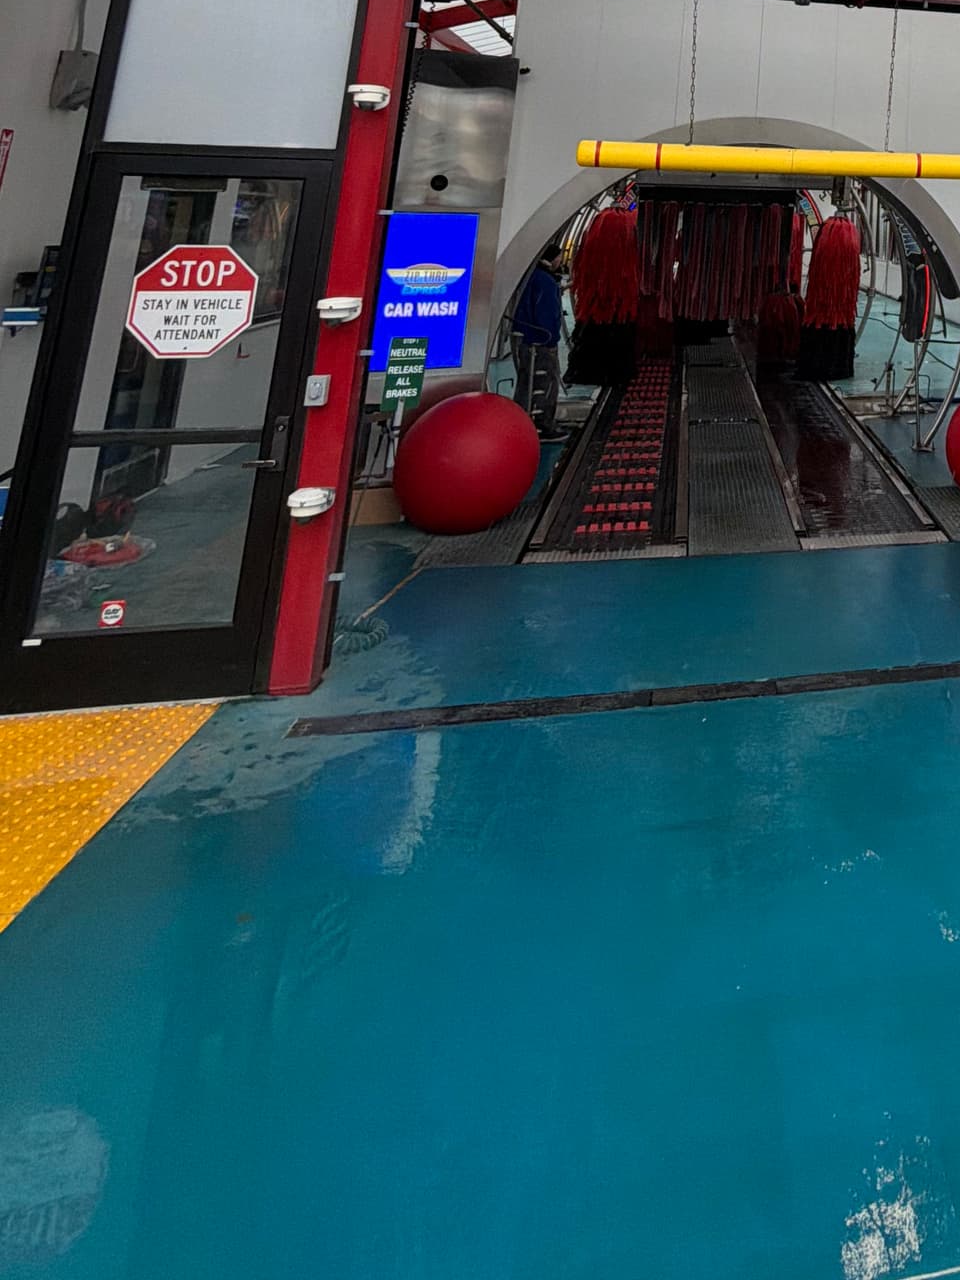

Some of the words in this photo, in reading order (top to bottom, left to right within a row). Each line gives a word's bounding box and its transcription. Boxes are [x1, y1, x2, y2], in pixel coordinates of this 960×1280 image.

[160, 260, 236, 287] STOP
[142, 299, 172, 310] STAY
[176, 299, 189, 310] IN
[193, 298, 243, 310] VEHICLE
[384, 302, 414, 317] CAR
[416, 301, 459, 317] WASH
[163, 315, 190, 325] WAIT
[193, 314, 217, 325] FOR
[154, 328, 221, 340] ATTENDANT
[390, 348, 427, 357] NEUTRAL
[387, 365, 425, 375] RELEASE
[396, 377, 411, 386] ALL
[385, 388, 418, 398] BRAKES
